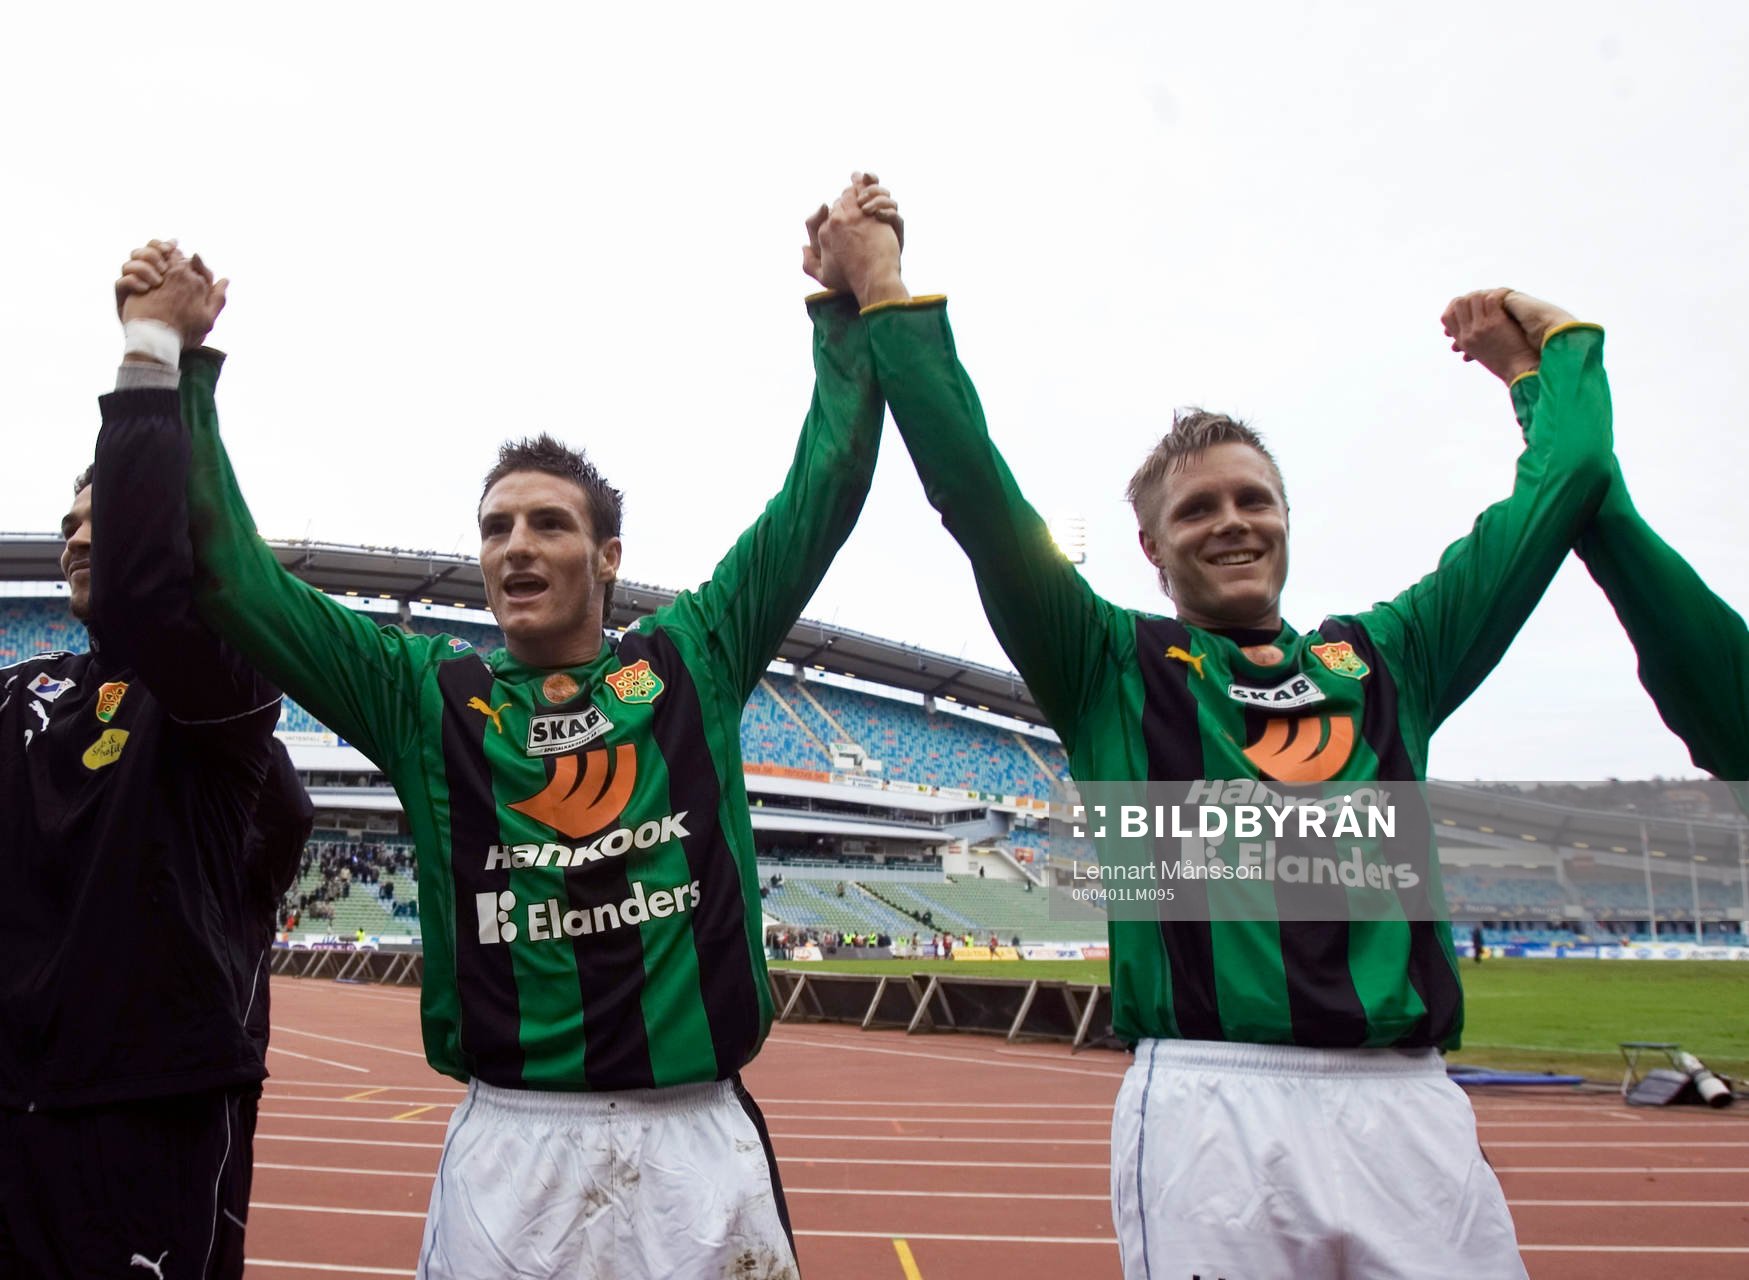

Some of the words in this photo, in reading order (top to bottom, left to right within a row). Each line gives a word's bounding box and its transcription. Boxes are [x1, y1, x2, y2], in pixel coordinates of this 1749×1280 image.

[1232, 680, 1310, 701] SKAB
[532, 710, 600, 742] SKAB
[1239, 840, 1420, 890] Elanders
[527, 880, 700, 942] Elanders
